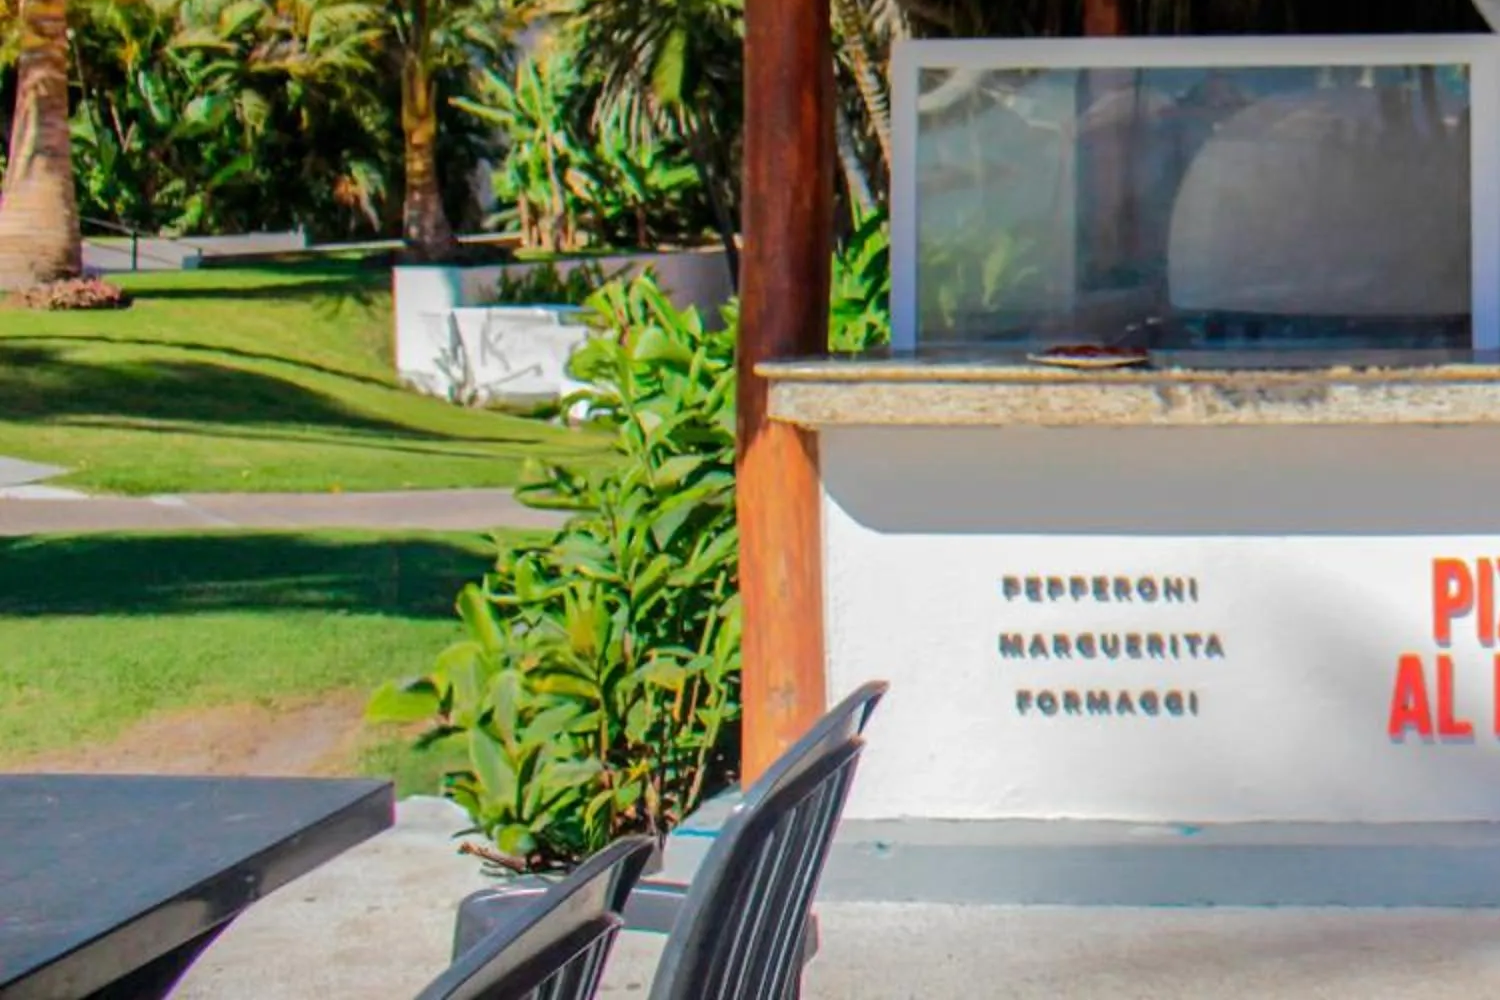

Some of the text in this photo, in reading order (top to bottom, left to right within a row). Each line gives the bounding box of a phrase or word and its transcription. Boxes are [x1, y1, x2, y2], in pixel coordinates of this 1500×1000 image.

[1002, 575, 1199, 602] PEPPERONI
[999, 632, 1226, 659] MARGUERITA
[1015, 689, 1199, 716] FORMAGGI
[1387, 653, 1475, 741] AL
